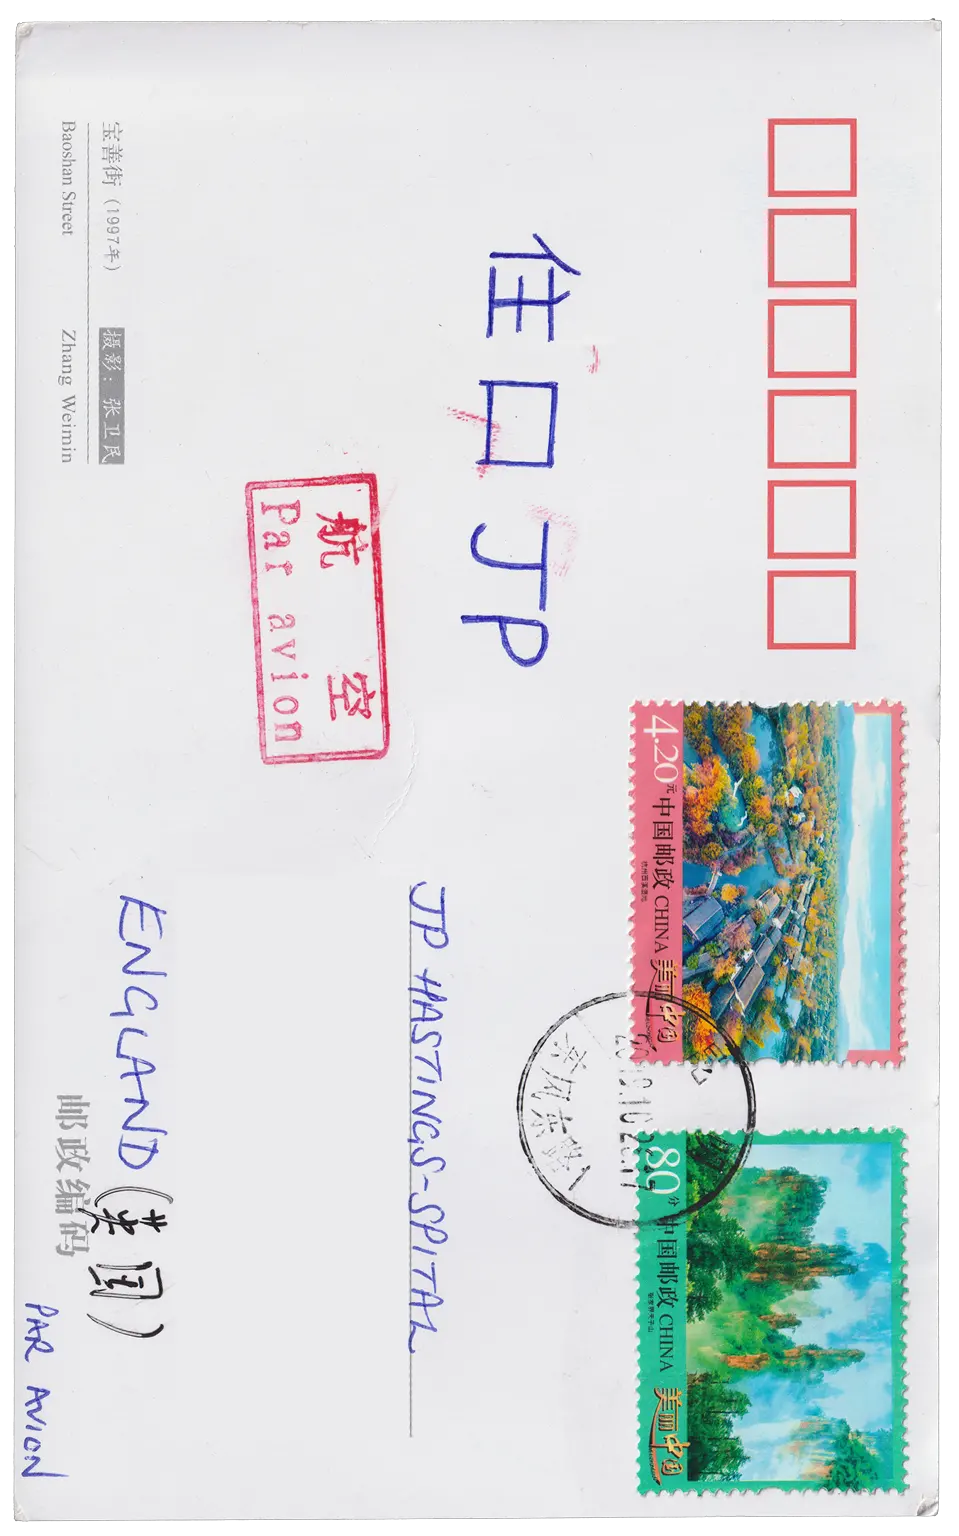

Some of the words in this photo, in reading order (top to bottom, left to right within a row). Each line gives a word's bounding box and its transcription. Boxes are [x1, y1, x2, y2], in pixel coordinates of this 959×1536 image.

[61, 121, 77, 186] Baoshan
[61, 191, 77, 236] Street
[58, 329, 77, 386] Zhang
[61, 394, 76, 464] Weimin
[260, 500, 301, 577] Par
[460, 521, 550, 669] JP
[266, 614, 309, 743] avion
[651, 797, 676, 890] 中国邮政
[409, 881, 450, 950] JP
[653, 895, 670, 954] CHINA
[110, 895, 168, 1170] ENGLAND
[646, 959, 686, 1049] 美丽中国
[54, 1094, 92, 1258] 邮政编码
[407, 968, 449, 1355] HASTINGS-SPITAL
[654, 1217, 680, 1309] 中国邮政
[24, 1302, 59, 1363] PAR
[657, 1314, 674, 1372] CHINA
[21, 1384, 69, 1479] AVION
[649, 1387, 691, 1481] 美丽中国
